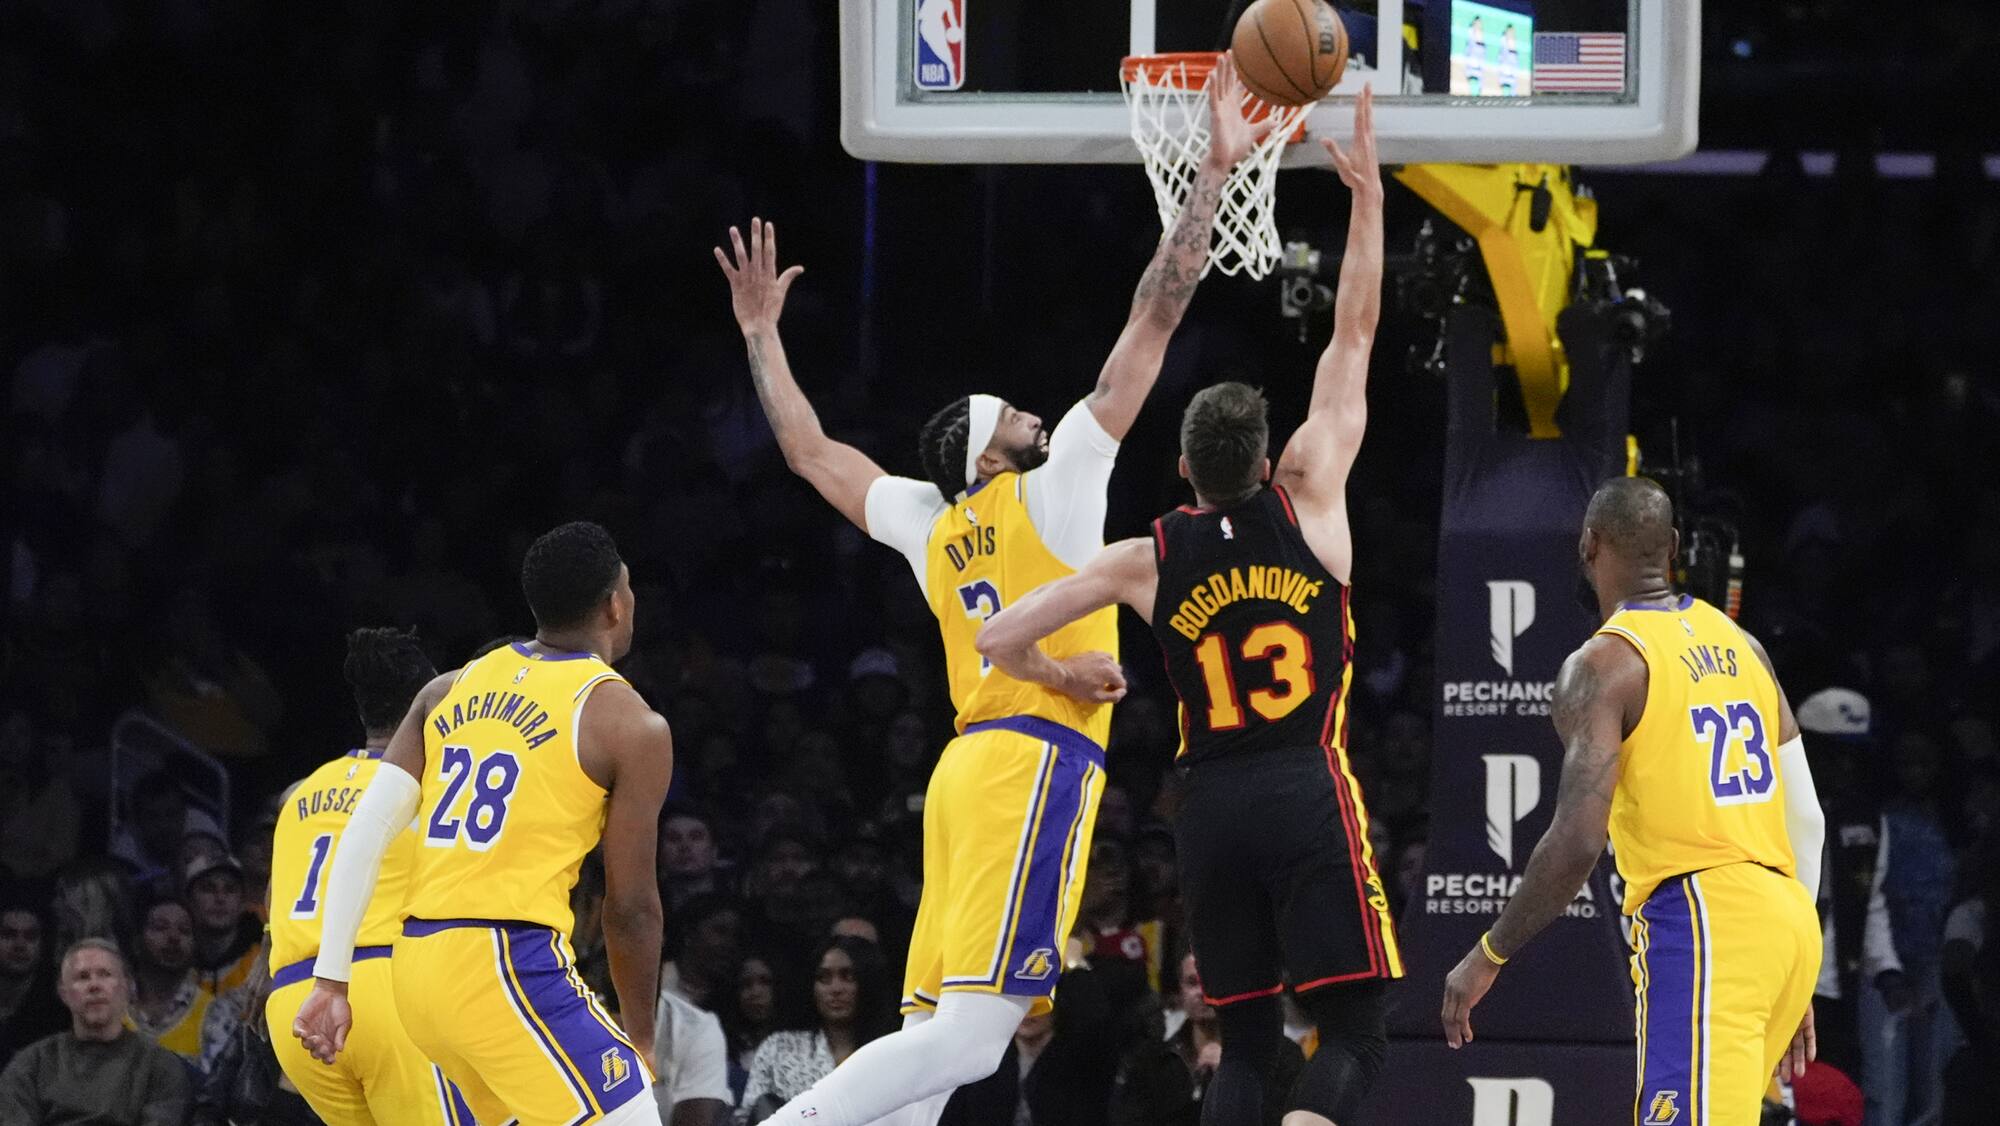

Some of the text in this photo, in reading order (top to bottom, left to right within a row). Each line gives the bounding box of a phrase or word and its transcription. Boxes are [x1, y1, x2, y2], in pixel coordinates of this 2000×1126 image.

[921, 63, 946, 82] NBA
[1169, 565, 1324, 642] BOGDANOVIĆ
[1193, 619, 1317, 732] 13
[1679, 644, 1738, 684] JAMES
[433, 691, 558, 751] HACHIMURA
[1443, 702, 1508, 717] RESORT
[1689, 700, 1778, 807] 23
[424, 744, 523, 853] 28
[288, 832, 334, 920] 1
[1426, 899, 1507, 915] RESORT
